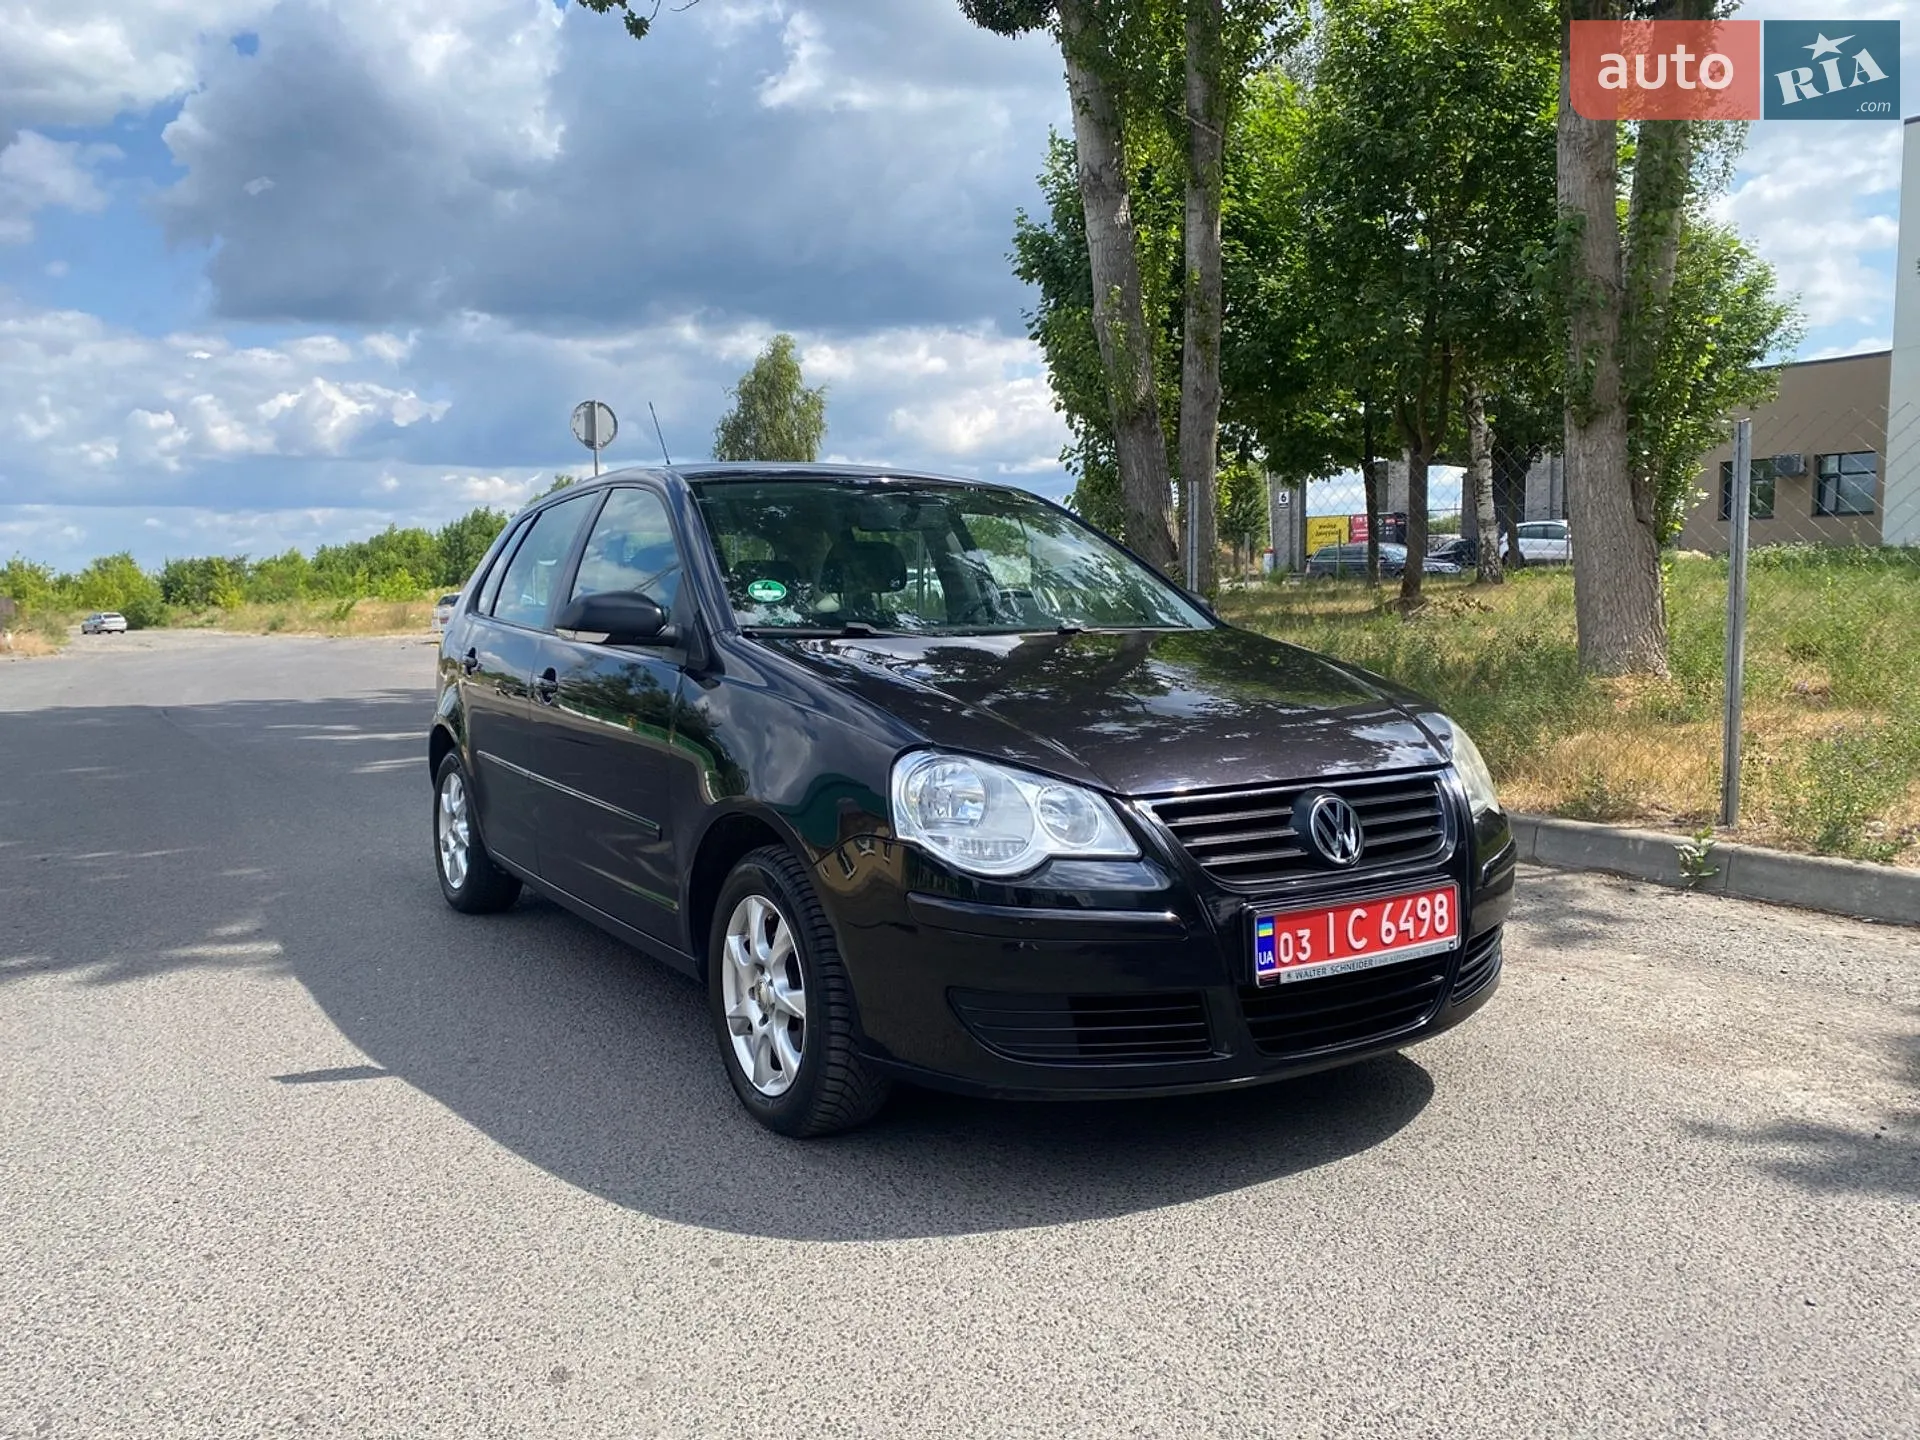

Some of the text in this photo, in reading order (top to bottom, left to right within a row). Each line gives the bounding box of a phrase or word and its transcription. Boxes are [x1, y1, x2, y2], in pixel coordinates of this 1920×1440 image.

[1278, 929, 1312, 964] 03
[1380, 893, 1449, 944] 6498
[1259, 950, 1274, 965] UA
[1295, 966, 1327, 979] WALTER
[1330, 958, 1373, 975] SCHNEIDER
